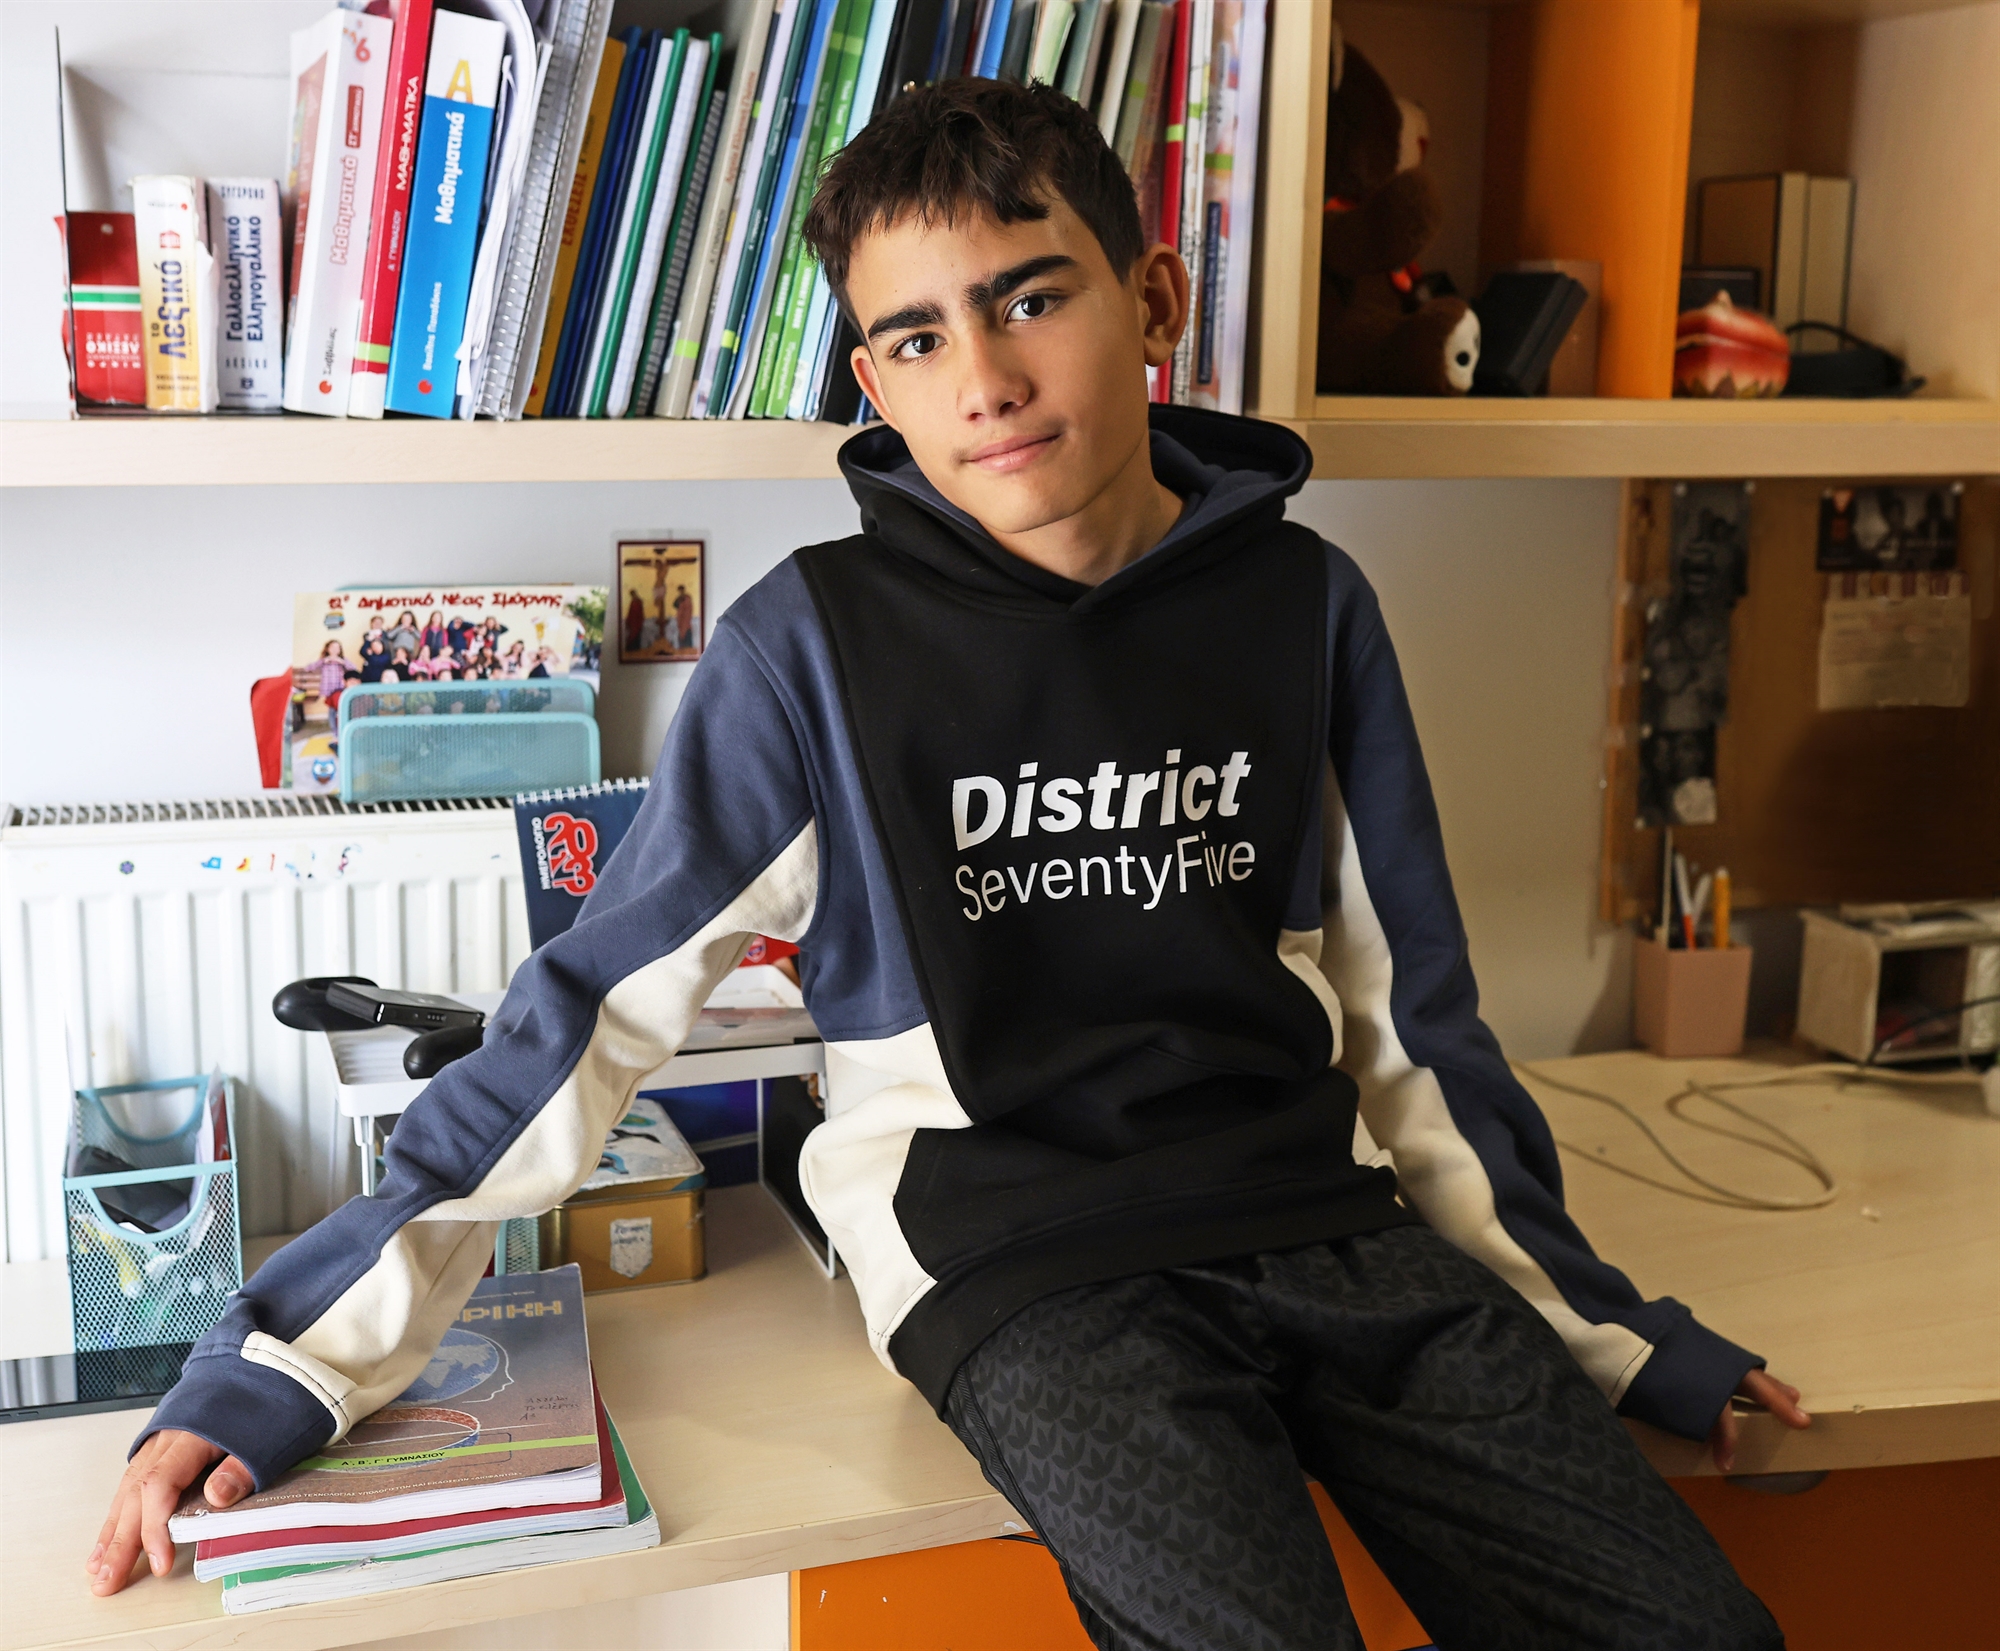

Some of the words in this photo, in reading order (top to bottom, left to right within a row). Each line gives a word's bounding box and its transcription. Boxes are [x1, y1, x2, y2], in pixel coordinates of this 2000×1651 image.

[355, 38, 370, 62] 6
[395, 75, 420, 191] ΜΑΘΗΜΑΤΙΚΑ
[433, 110, 466, 224] Μαθηματικά
[331, 155, 359, 265] Μαθηματικά
[153, 260, 189, 358] Λεξικό
[223, 216, 244, 341] Γαλλοελληνικό
[244, 216, 266, 341] Ελληνογαλλικό
[357, 593, 434, 611] Δημοτικό
[441, 593, 484, 609] Νέας
[491, 592, 563, 609] Σμύρνης
[951, 748, 1252, 851] District
[531, 817, 552, 890] ΗΜΕΡΟΛΟΓΙΟ
[954, 830, 1256, 921] SeventyFive
[256, 1493, 301, 1502] ΙΝΣΤΙΤΟΥΤΟ
[357, 1485, 411, 1496] ΥΠΟΛΟΓΙΣΤΩΝ
[427, 1477, 470, 1485] ΕΚΔΟΣΕΩΝ
[386, 1451, 446, 1463] ΓΥΜΝΑΣΙΟΥ
